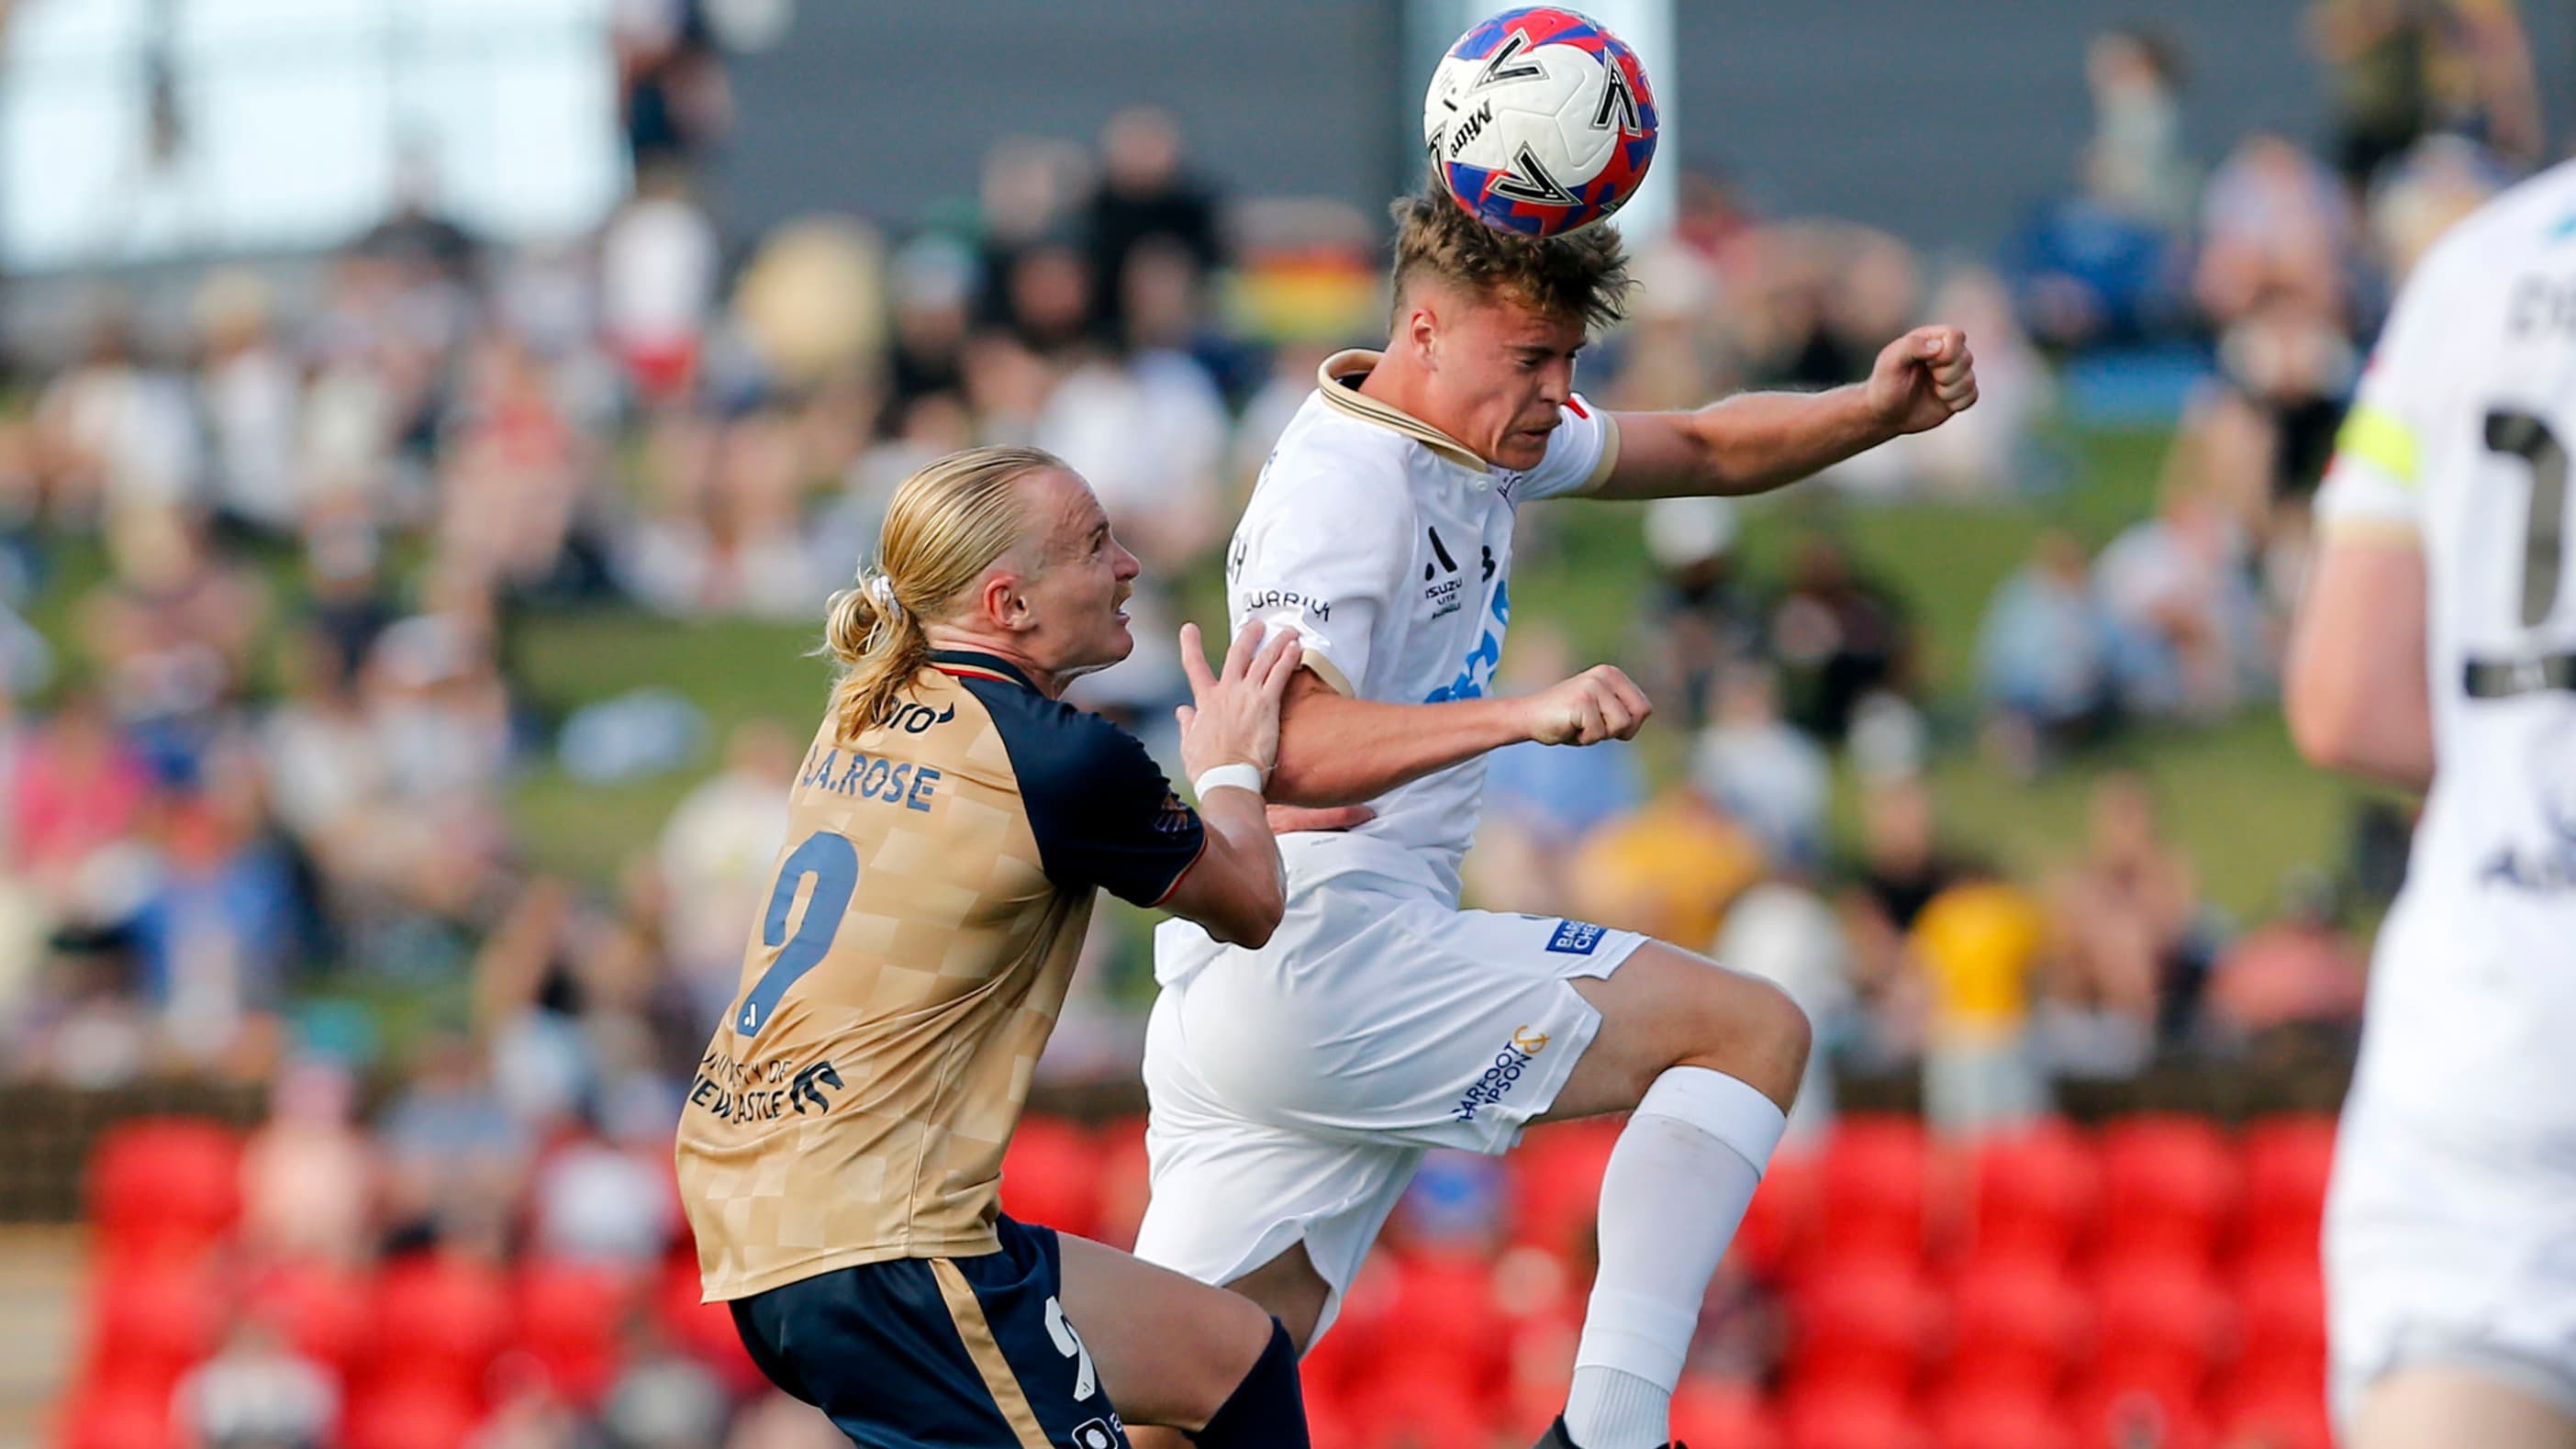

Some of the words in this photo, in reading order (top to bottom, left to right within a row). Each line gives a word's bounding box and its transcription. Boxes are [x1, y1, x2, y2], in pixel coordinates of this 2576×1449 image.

[1450, 98, 1492, 158] Mitre
[1425, 578, 1463, 599] ISUZU
[737, 830, 859, 1037] 9
[1450, 1040, 1520, 1121] ARFOOT
[1044, 1295, 1096, 1402] 9
